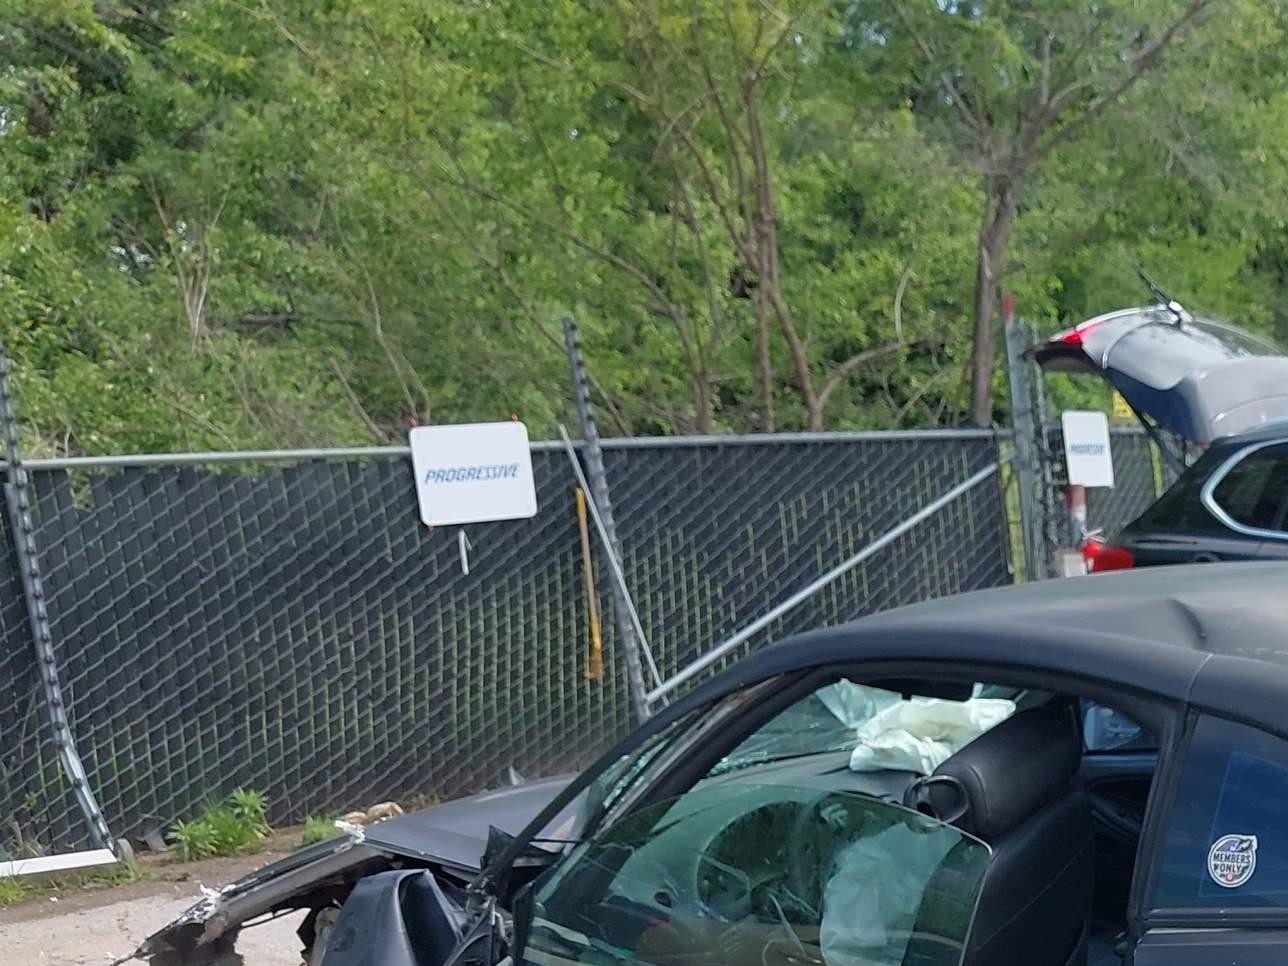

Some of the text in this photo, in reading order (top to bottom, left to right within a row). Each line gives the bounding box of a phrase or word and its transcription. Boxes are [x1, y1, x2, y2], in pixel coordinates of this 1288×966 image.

[424, 463, 520, 484] PROGRESSIVE
[1213, 852, 1251, 865] MEMBERS
[1220, 863, 1242, 873] ONLY
